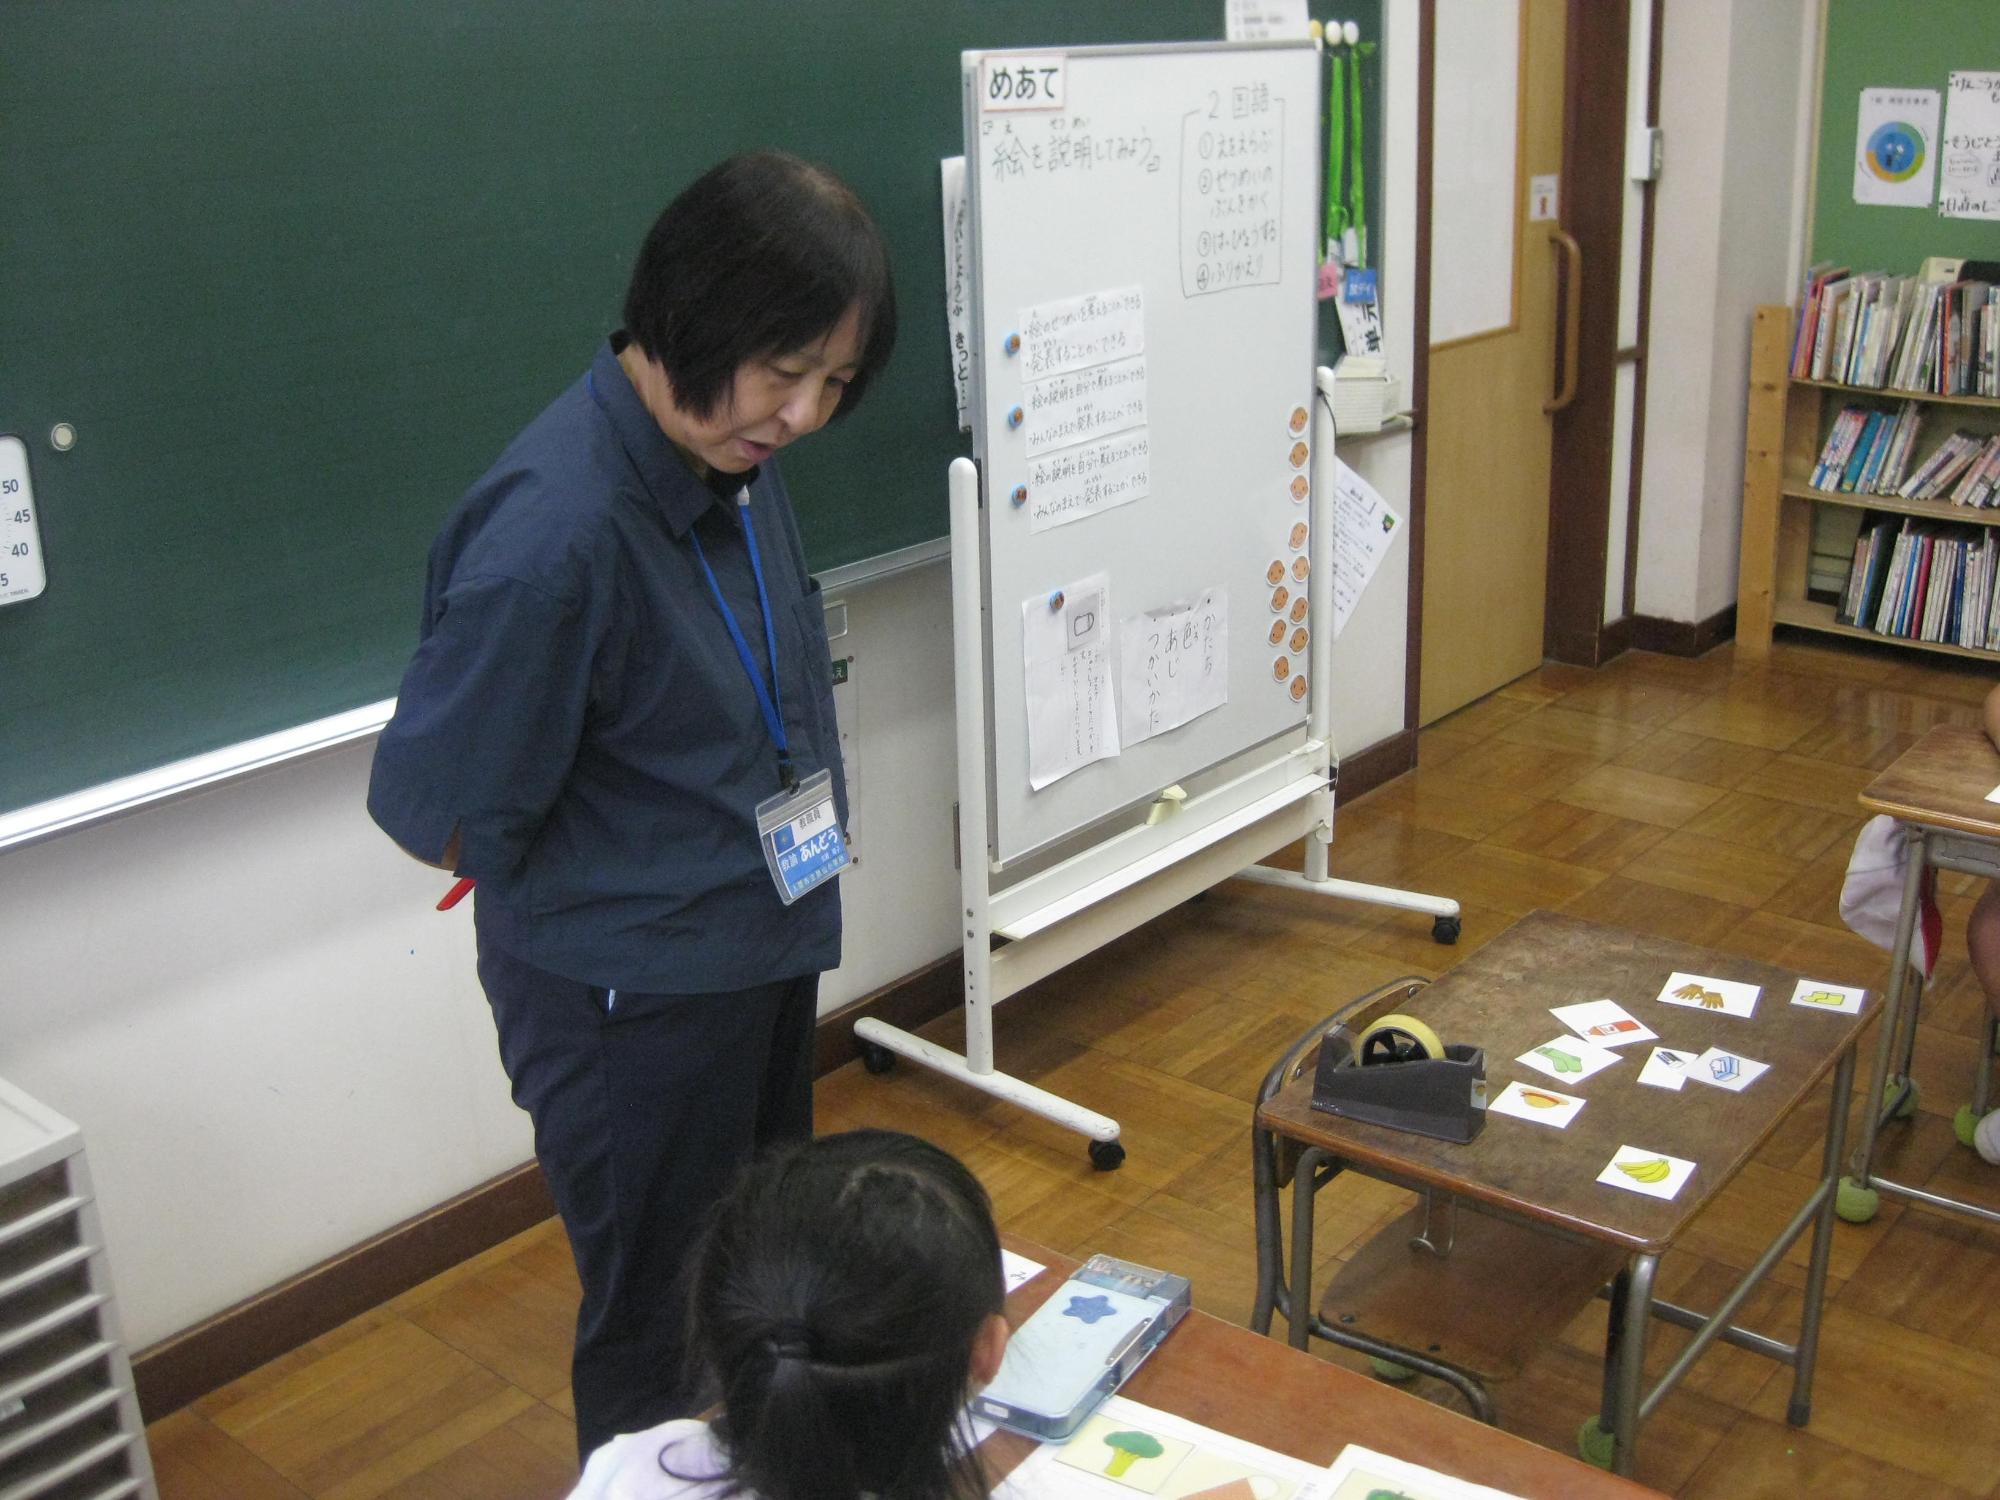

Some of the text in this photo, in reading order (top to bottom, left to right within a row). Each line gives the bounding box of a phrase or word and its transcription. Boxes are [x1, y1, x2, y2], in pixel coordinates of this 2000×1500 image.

[989, 66, 1059, 100] めあて
[1231, 82, 1269, 119] 国語
[2, 478, 19, 494] 50
[13, 508, 31, 524] 45
[11, 542, 29, 558] 40
[0, 573, 9, 587] 5
[800, 829, 838, 862] あんどう
